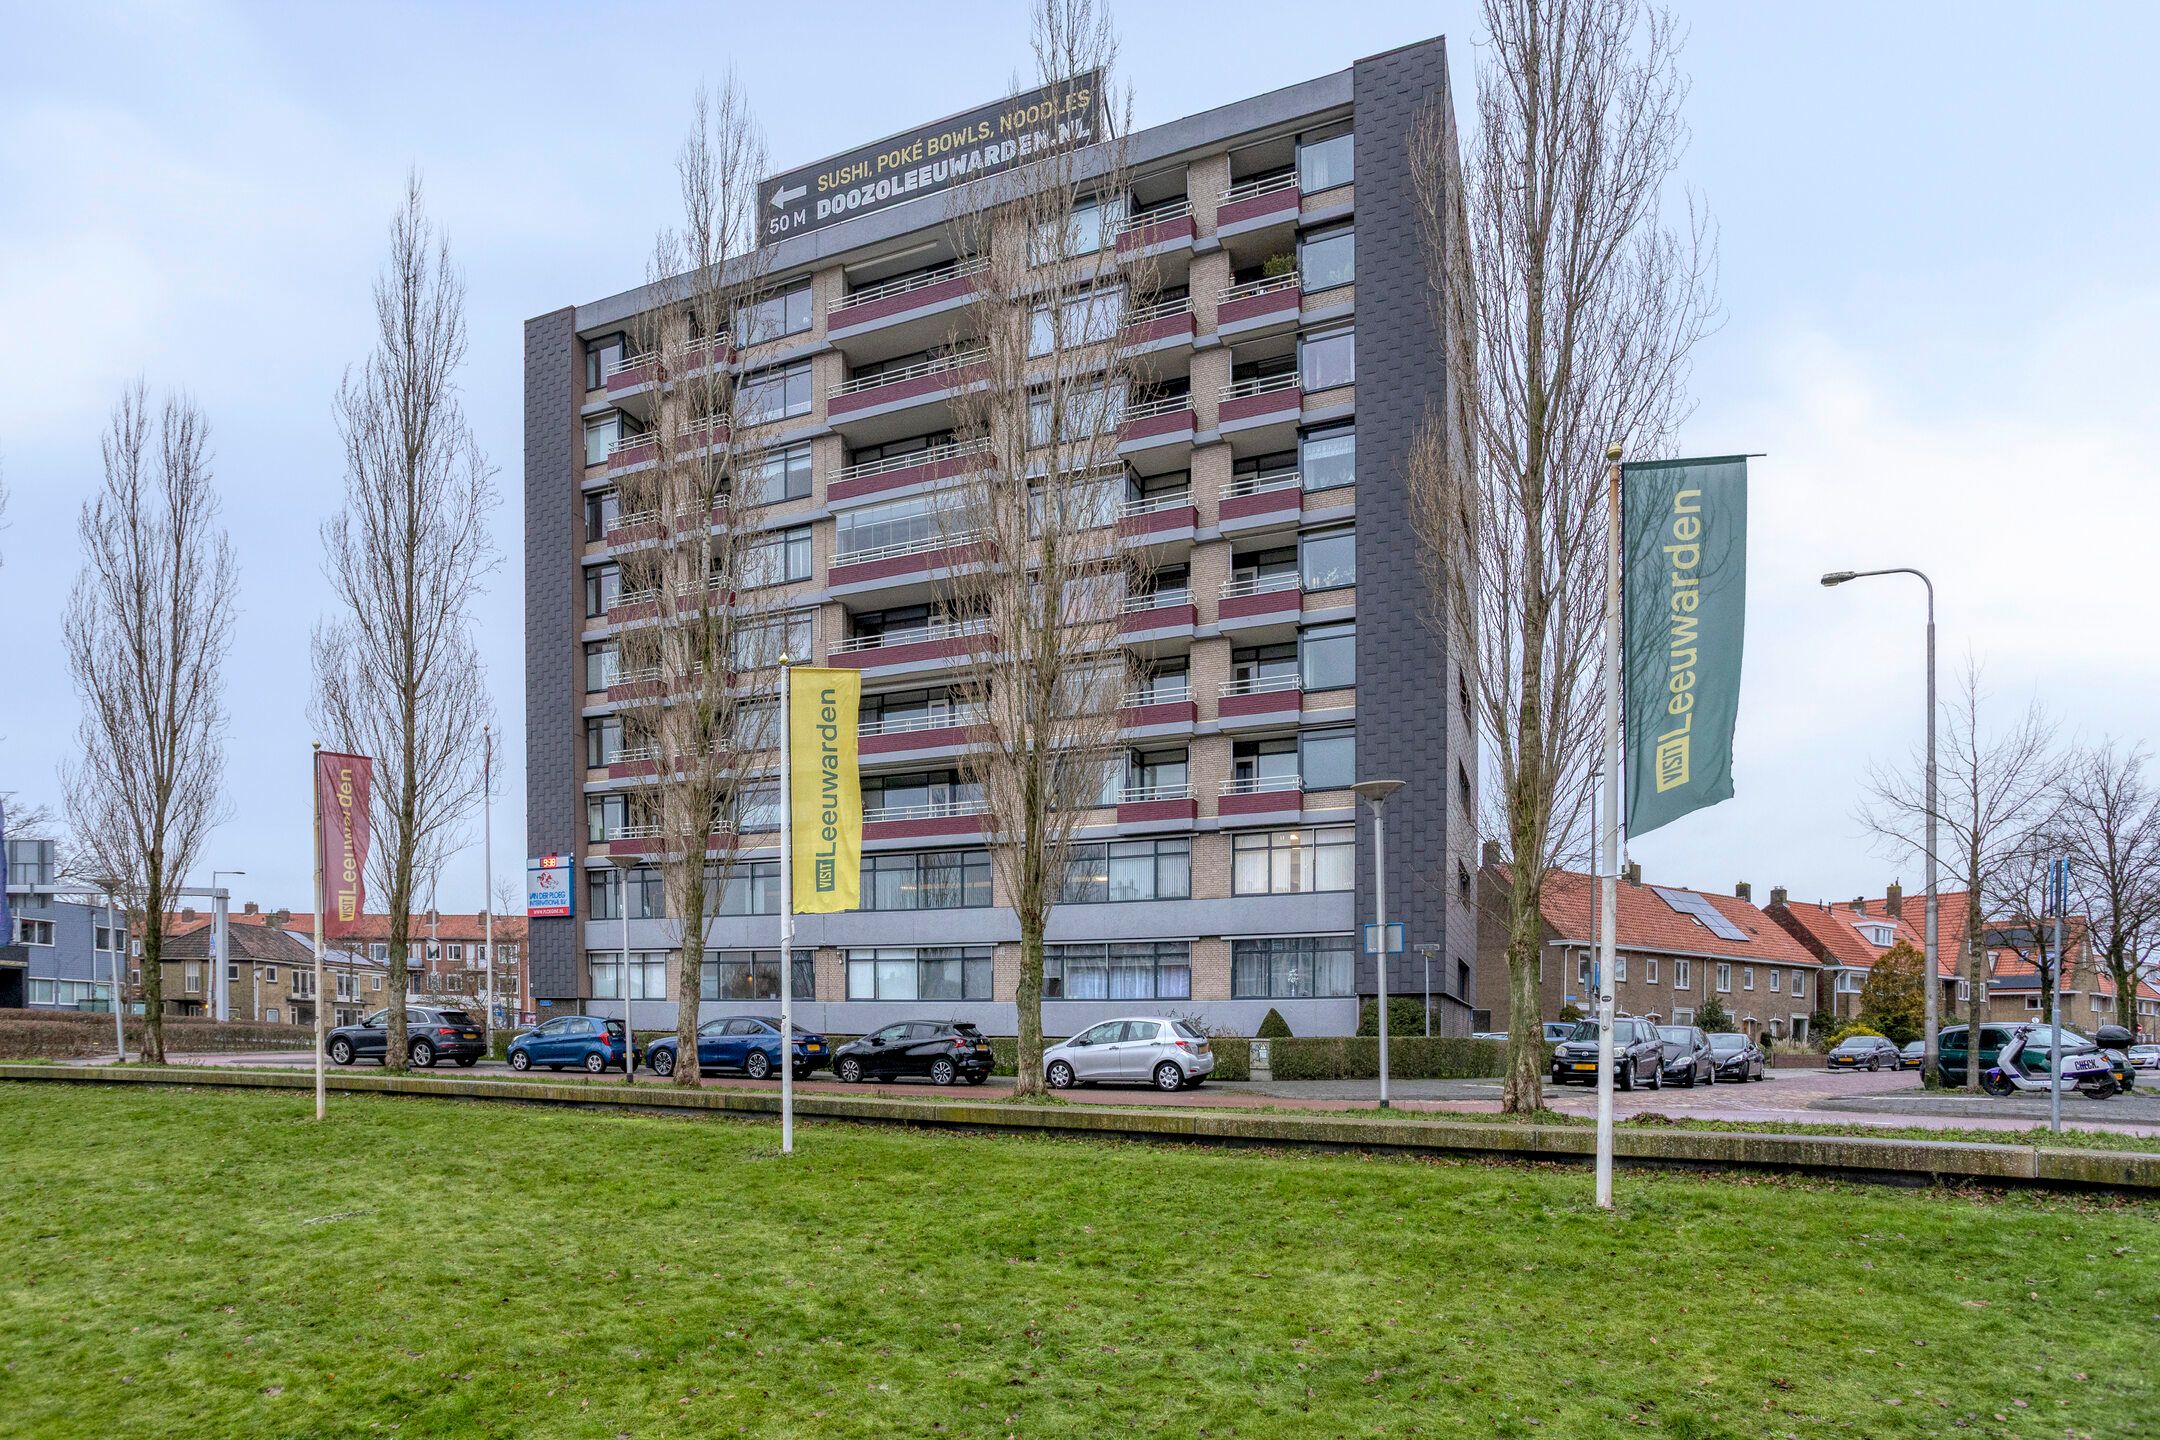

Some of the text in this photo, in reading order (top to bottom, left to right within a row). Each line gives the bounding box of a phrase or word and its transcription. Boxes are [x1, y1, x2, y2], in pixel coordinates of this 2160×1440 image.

[816, 118, 1091, 220] DOOZOLEEUWARDEN.NL
[817, 163, 873, 193] SUSHI,
[877, 140, 923, 173] POKÉ
[927, 121, 995, 157] BOWLS,
[769, 209, 806, 235] 50 M
[1658, 489, 1702, 785] VISIT Leeuwarden
[816, 688, 839, 891] VISIT Leeuwarden
[341, 898, 354, 920] VISIT
